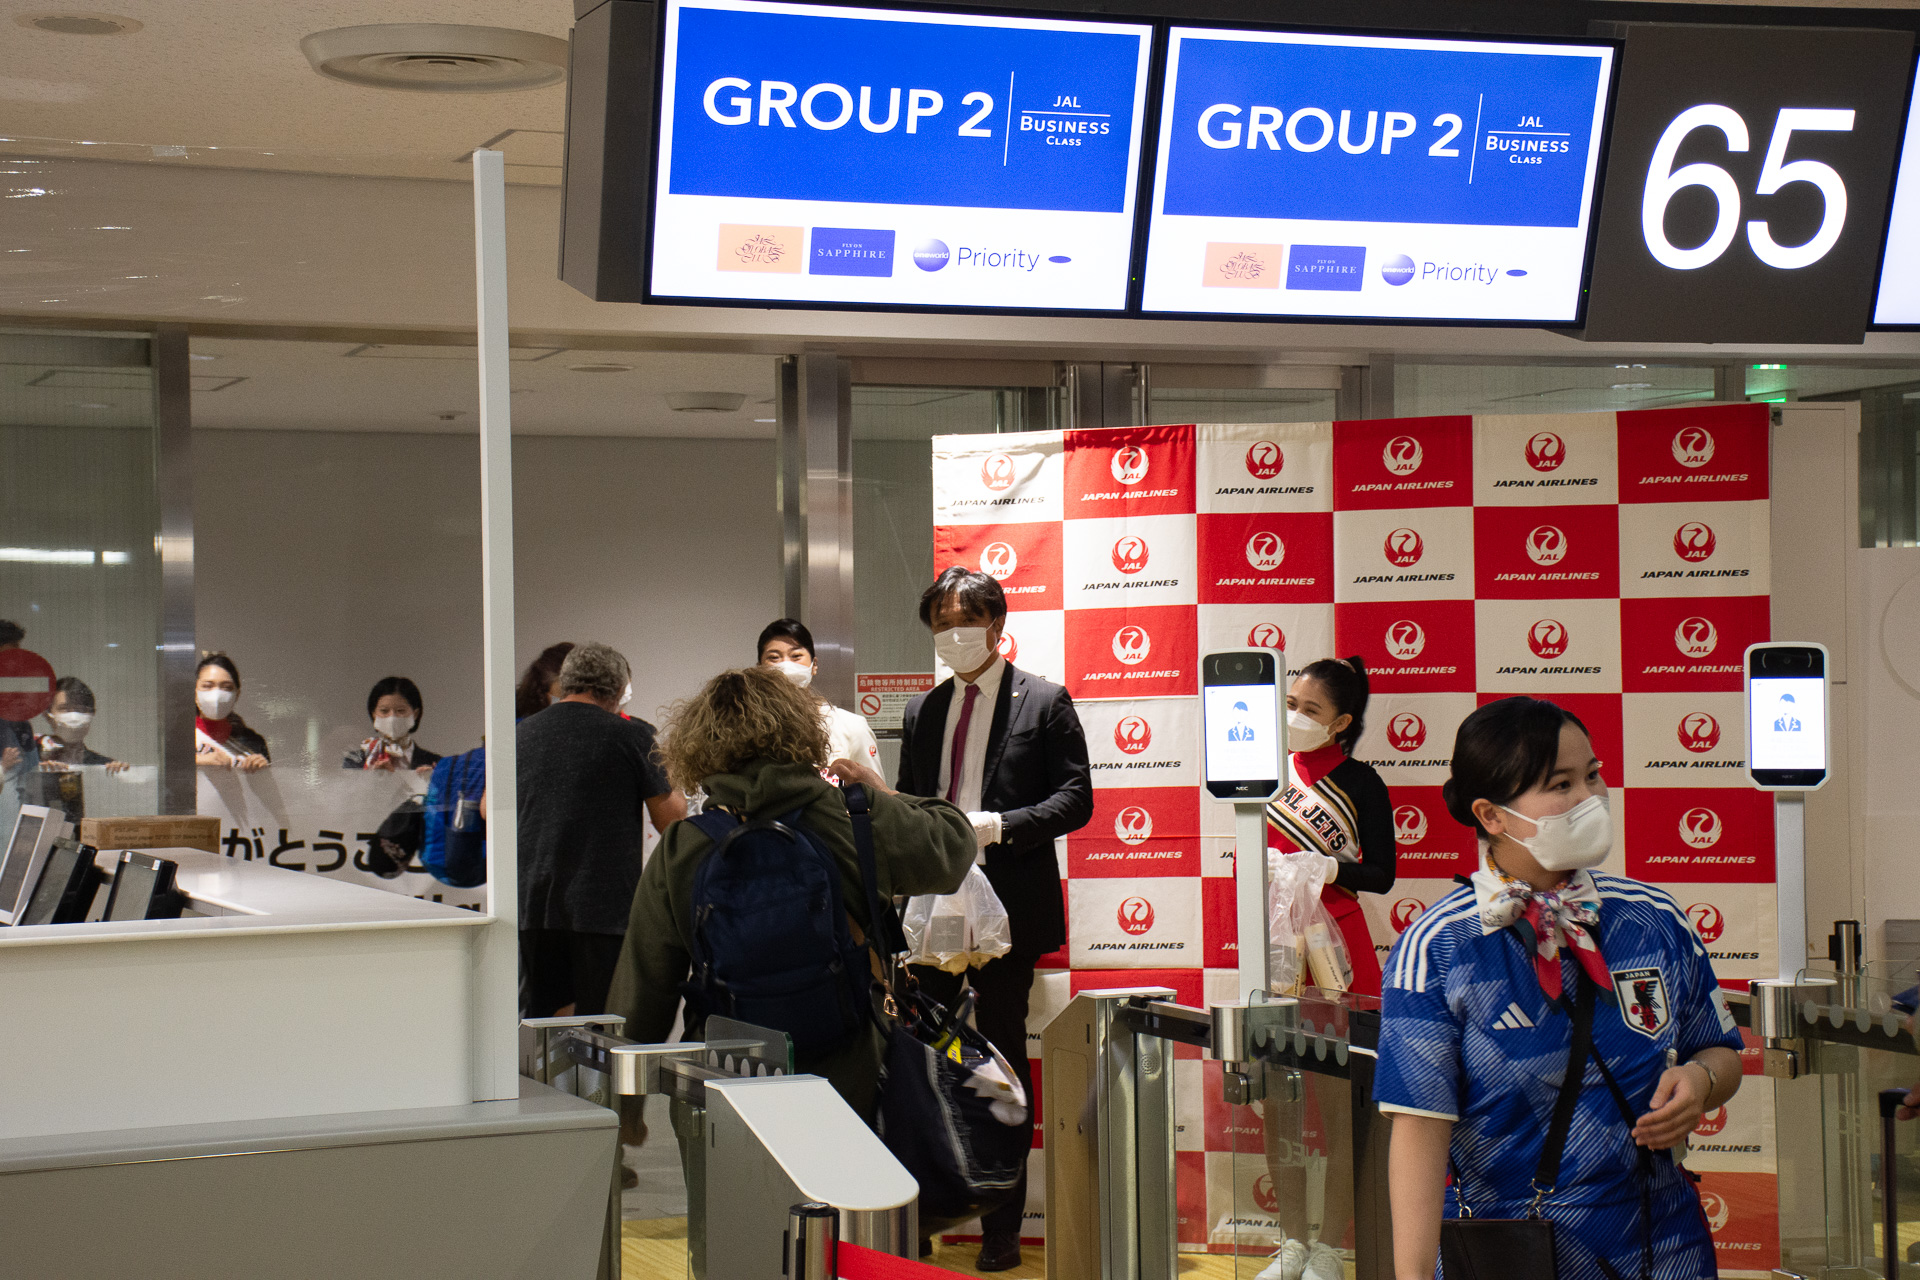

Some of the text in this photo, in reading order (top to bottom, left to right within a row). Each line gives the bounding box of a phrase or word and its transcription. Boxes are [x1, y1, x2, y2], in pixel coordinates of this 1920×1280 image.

[1052, 95, 1082, 109] JAL
[703, 77, 995, 138] GROUP 2
[1020, 115, 1111, 136] BUSINESS
[1517, 115, 1544, 129] JAL
[1198, 103, 1463, 158] GROUP 2
[1485, 135, 1570, 154] BUSINESS
[1641, 103, 1856, 270] 65
[818, 248, 887, 259] SAPPHIRE
[914, 251, 949, 260] oneworld
[957, 246, 1041, 272] Priority
[1294, 264, 1358, 274] SAPPHIRE
[1382, 266, 1415, 274] oneworld
[1422, 261, 1498, 285] Priority
[1535, 459, 1558, 468] JAL
[1683, 455, 1707, 463] JAL
[1393, 463, 1415, 471] JAL
[1255, 468, 1277, 476] JAL
[989, 479, 1010, 488] JAL
[1493, 478, 1598, 488] JAPAN AIRLINES
[1638, 474, 1749, 484] JAPAN AIRLINES
[1215, 486, 1314, 495] JAPAN AIRLINES
[1352, 480, 1454, 492] JAPAN AIRLINES
[1081, 489, 1178, 501] JAPAN AIRLINES
[950, 496, 1045, 507] JAPAN AIRLINES
[1537, 553, 1560, 561] JAL
[1684, 550, 1708, 558] JAL
[1256, 559, 1277, 567] JAL
[1394, 555, 1416, 563] JAL
[1121, 563, 1142, 571] JAL
[1353, 573, 1455, 583] JAPAN AIRLINES
[1494, 572, 1600, 581] JAPAN AIRLINES
[1640, 569, 1749, 579] JAPAN AIRLINES
[1082, 579, 1179, 591] JAPAN AIRLINES
[1215, 577, 1315, 586] JAPAN AIRLINES
[1538, 647, 1561, 655] JAL
[1686, 645, 1710, 653] JAL
[1123, 652, 1144, 660] JAL
[1397, 666, 1457, 675] AIRLINES
[1642, 665, 1745, 674] JAPAN AIRLINE
[1083, 670, 1180, 680] JAPAN AIRLINES
[1124, 743, 1145, 751] JAL
[1397, 740, 1419, 748] JAL
[1689, 741, 1713, 749] JAL
[1125, 761, 1181, 769] AIRLINES
[1282, 785, 1348, 852] AL JETS
[1125, 833, 1146, 841] JAL
[1690, 836, 1714, 844] JAL
[1085, 851, 1183, 860] JAPAN AIRLINES
[1399, 852, 1460, 860] AIRLINES
[1646, 856, 1756, 864] JAPAN AIRLINES
[1127, 923, 1148, 931] JAL
[1701, 931, 1717, 940] AL
[1128, 942, 1185, 950] AIRLINES
[1624, 971, 1651, 980] JAPAN
[1638, 1014, 1661, 1026] JFA
[1223, 1126, 1260, 1135] JAPAN
[1696, 1124, 1719, 1132] JAL
[1698, 1144, 1761, 1153] AIRLINES
[1226, 1217, 1263, 1227] JAPAN
